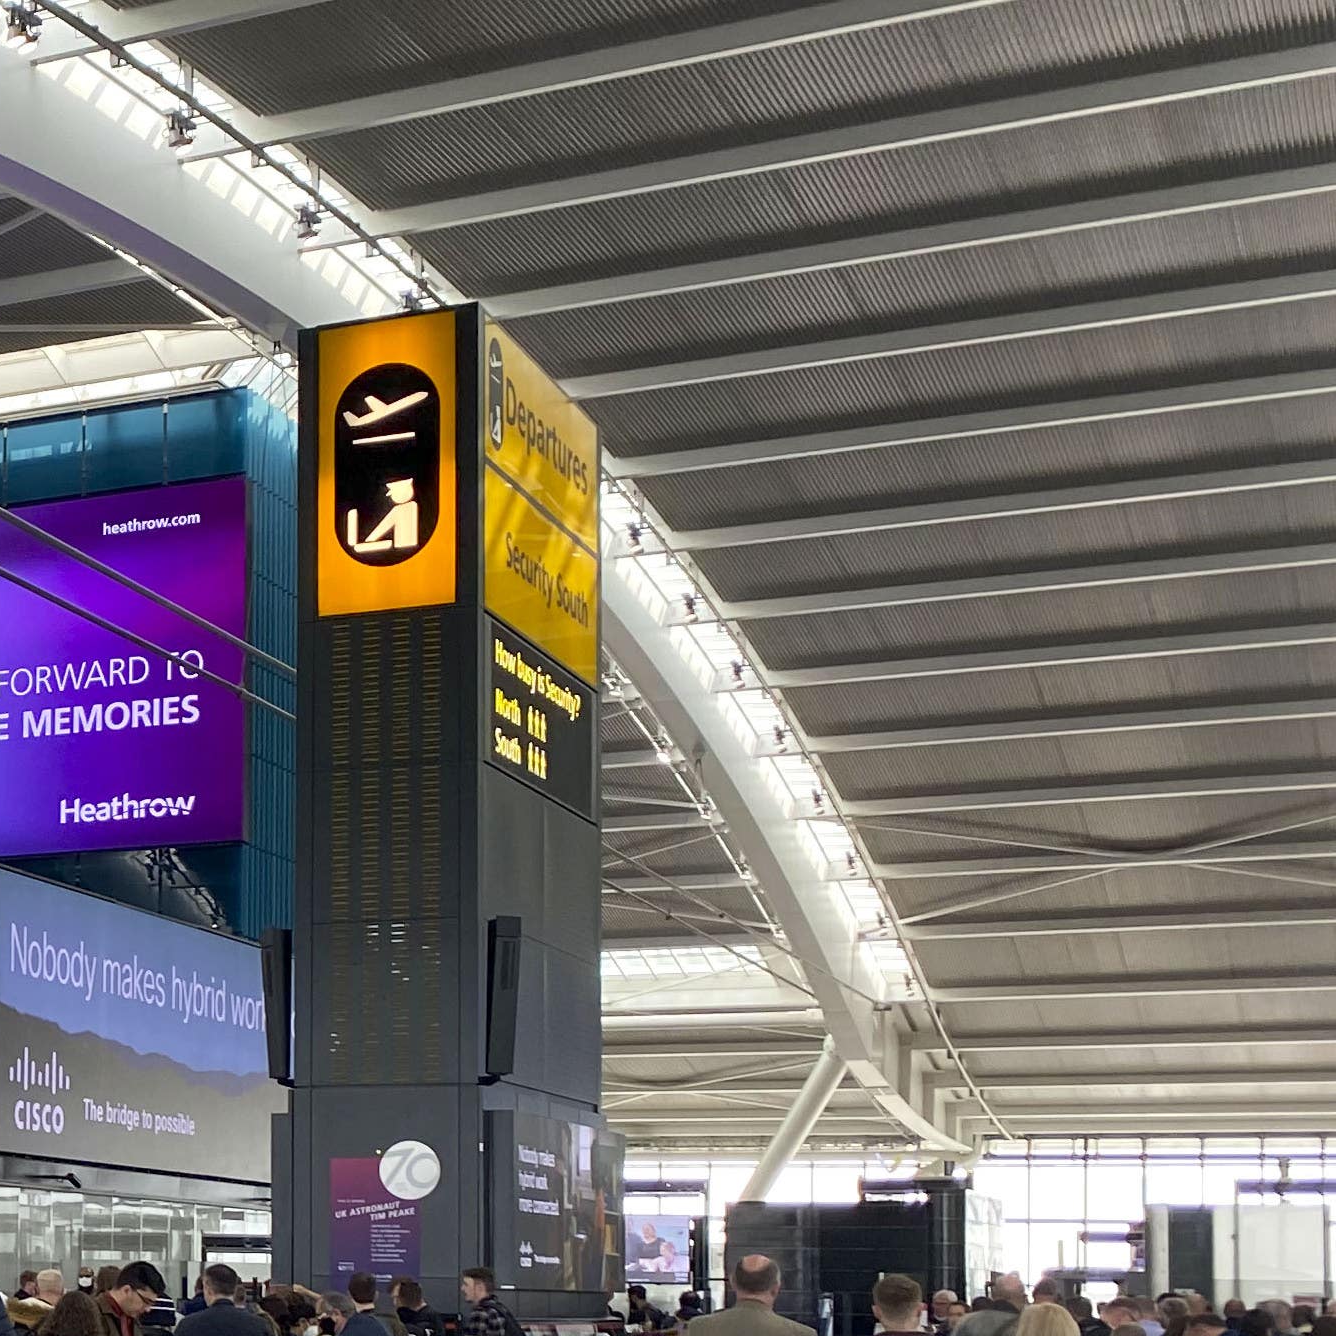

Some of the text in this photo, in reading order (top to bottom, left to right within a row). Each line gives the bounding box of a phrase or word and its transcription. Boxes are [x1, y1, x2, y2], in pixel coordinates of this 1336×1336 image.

[505, 377, 588, 496] Departures
[102, 513, 201, 536] heathrow.com
[506, 531, 589, 628] Security South
[165, 649, 204, 682] TO
[495, 638, 517, 675] How
[537, 665, 545, 694] is
[545, 674, 582, 722] Security?
[22, 694, 201, 739] MEMORIES
[495, 687, 521, 727] North
[494, 727, 522, 765] South
[60, 793, 196, 824] Heathrow
[10, 922, 97, 1002] Nobody
[102, 954, 167, 1008] makes
[171, 965, 227, 1024] hybrid
[14, 1098, 197, 1136] CISCO The bridge to possible
[385, 1147, 438, 1189] 70
[335, 1200, 401, 1219] UK ASTRONAUT
[369, 1207, 416, 1221] TIM PEAKE
